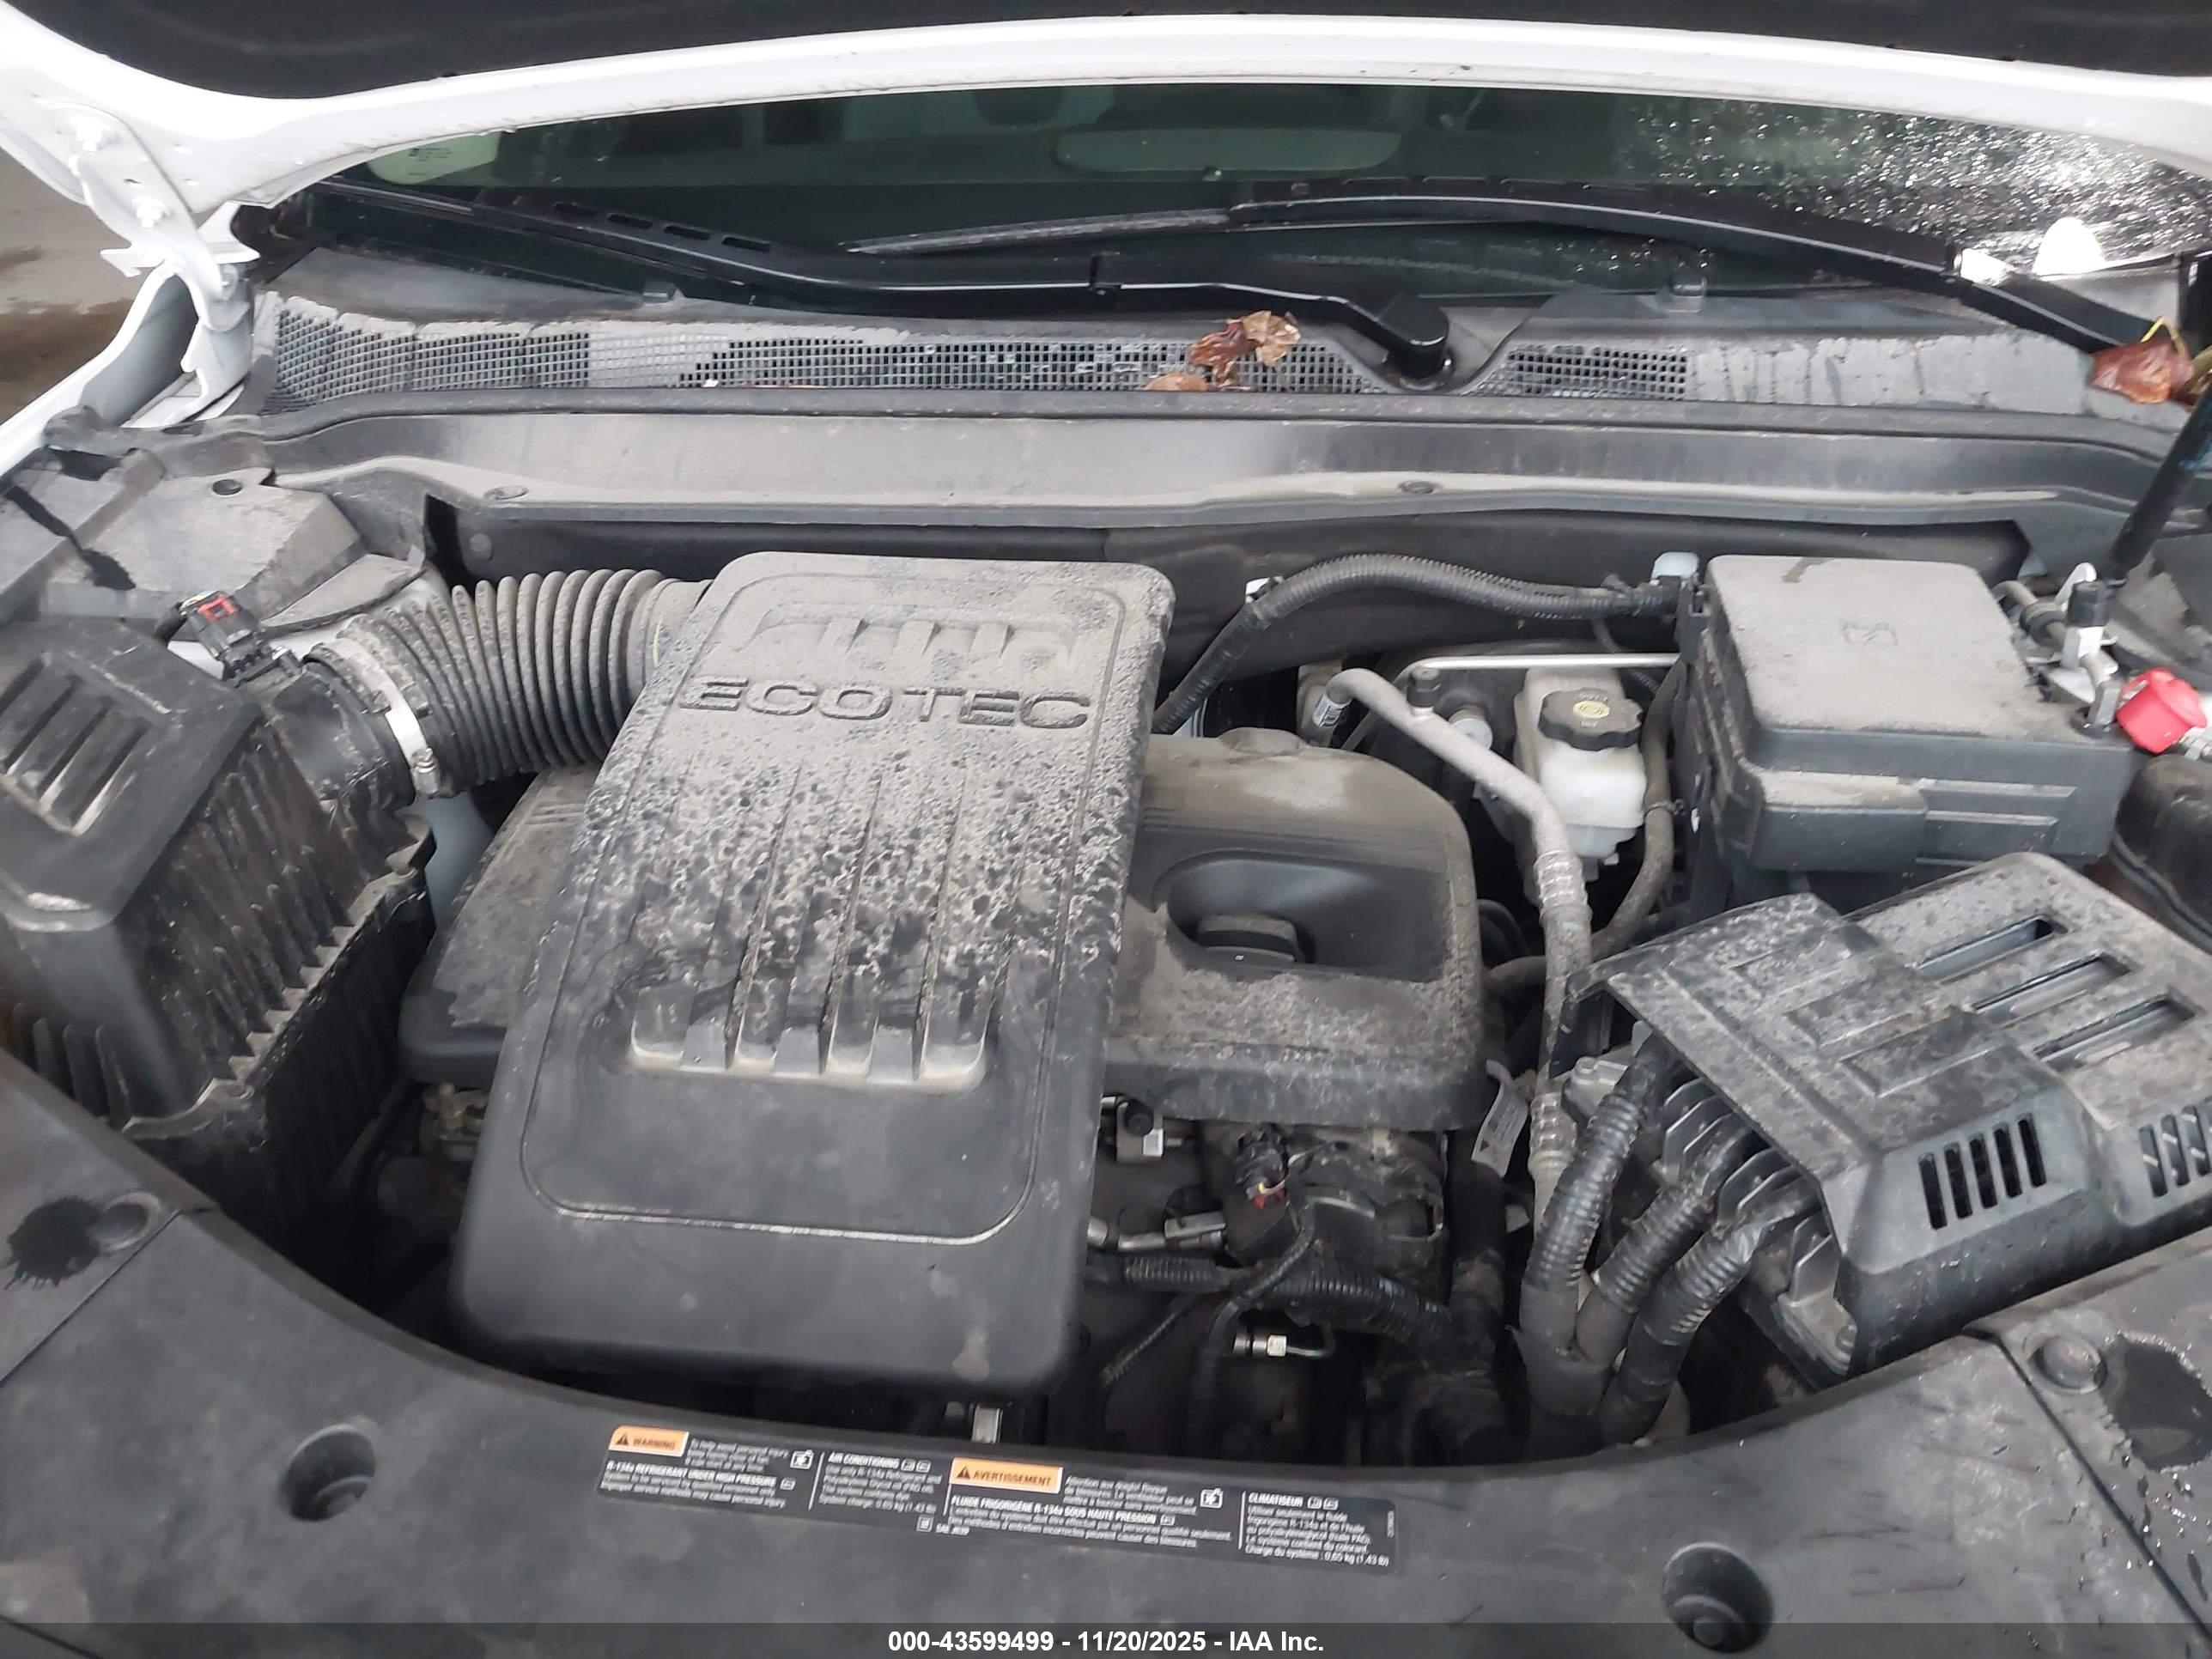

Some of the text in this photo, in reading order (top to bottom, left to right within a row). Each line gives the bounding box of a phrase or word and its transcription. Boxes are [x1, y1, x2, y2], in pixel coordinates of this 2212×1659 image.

[680, 678, 1091, 729] ECOTEC
[633, 1436, 675, 1449] WARNING
[829, 1452, 900, 1468] AIR CONDITIONING
[606, 1461, 634, 1472] R-134a
[635, 1463, 688, 1477] REFRIGERANT
[688, 1469, 715, 1481] UNDER
[715, 1471, 736, 1483] HIGH
[736, 1474, 776, 1487] PRESSURE
[973, 1469, 1051, 1486] AVERTISSEMENT
[819, 1494, 847, 1504] System
[893, 1501, 904, 1513] kg
[951, 1494, 981, 1505] FLUIDE
[1034, 1503, 1064, 1516] R-134a
[1064, 1505, 1086, 1518] SOUS
[1087, 1508, 1115, 1521] HAUTE
[1115, 1510, 1157, 1524] PRESSION
[1249, 1492, 1304, 1508] CLIMATISEUR
[1246, 1545, 1273, 1558] Charge
[1273, 1547, 1285, 1558] du
[1344, 1553, 1355, 1565] kg
